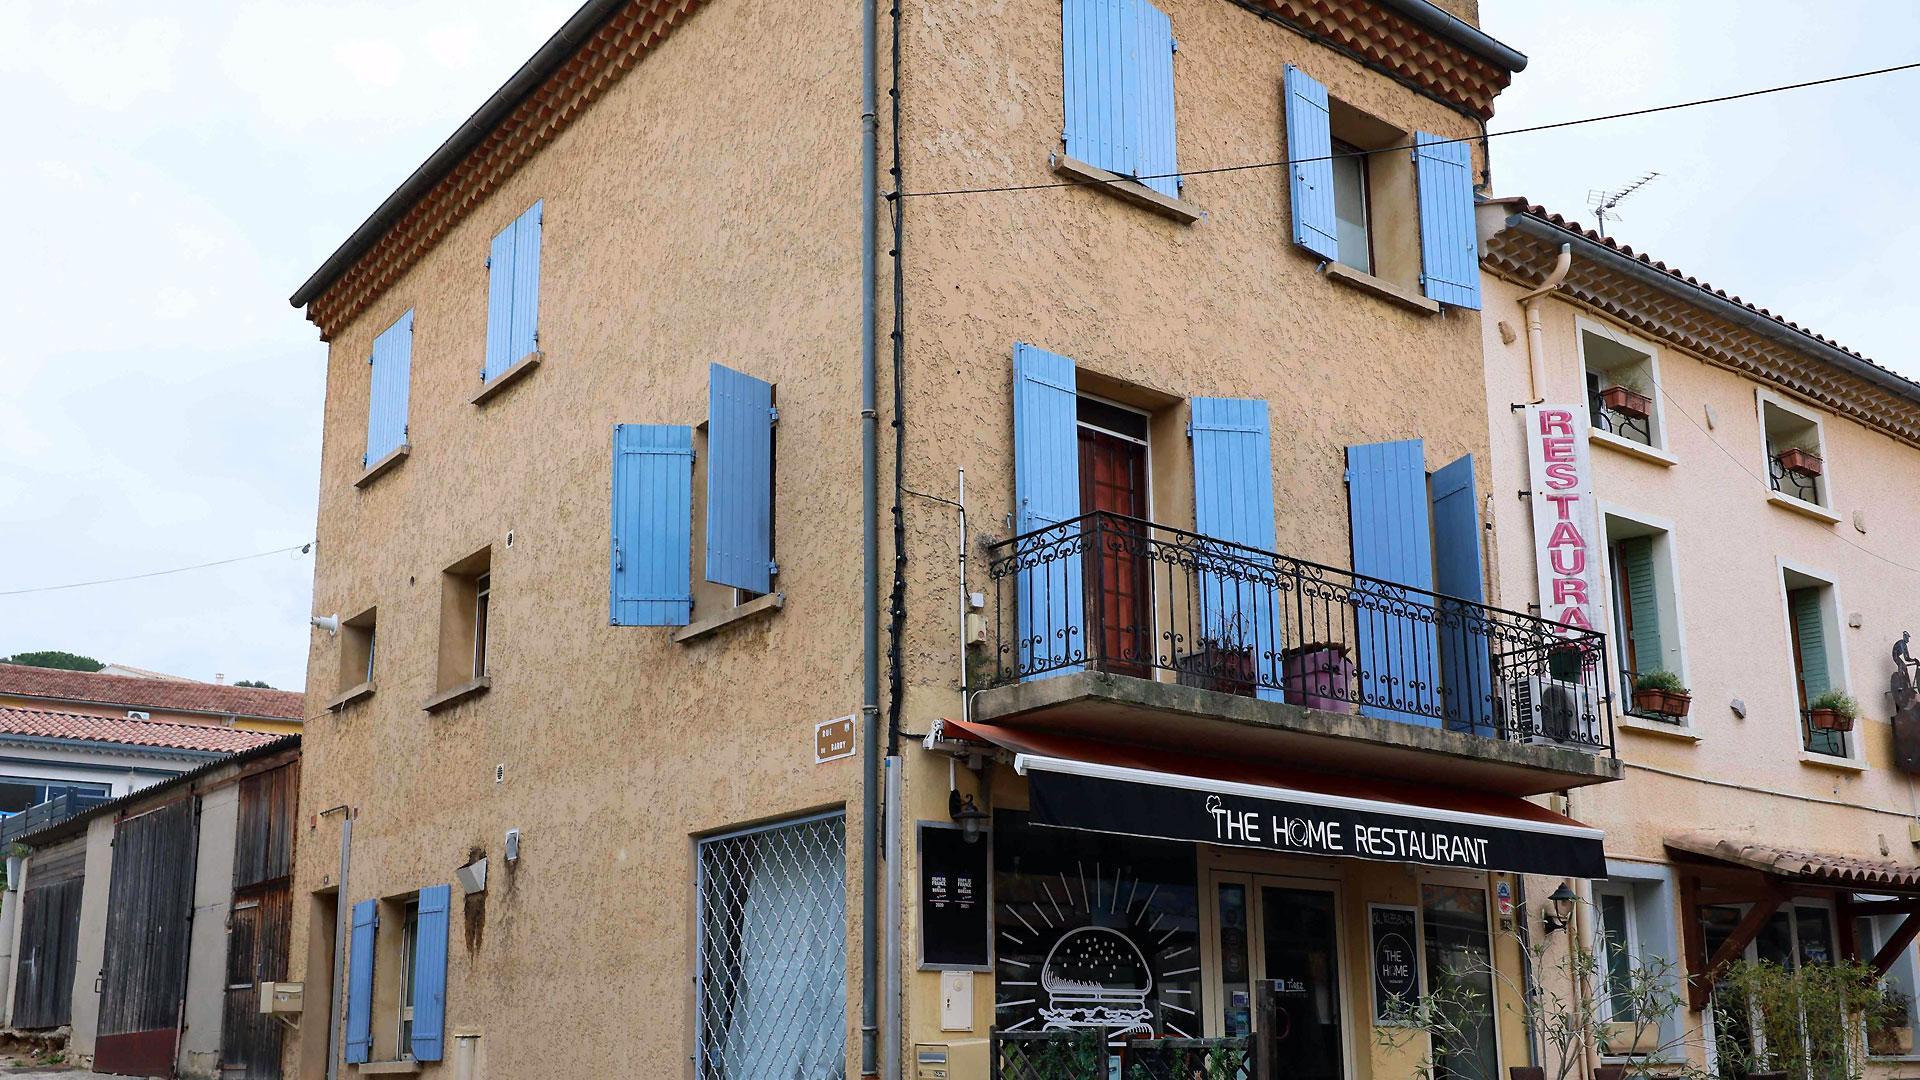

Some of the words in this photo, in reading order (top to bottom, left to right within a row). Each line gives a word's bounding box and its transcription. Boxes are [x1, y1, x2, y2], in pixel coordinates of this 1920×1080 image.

[1539, 410, 1596, 684] RESTAURA
[1212, 808, 1260, 841] THE
[1272, 815, 1344, 850] HOME
[1355, 823, 1488, 865] RESTAURANT
[1382, 964, 1409, 977] HOME
[1384, 950, 1402, 962] THE
